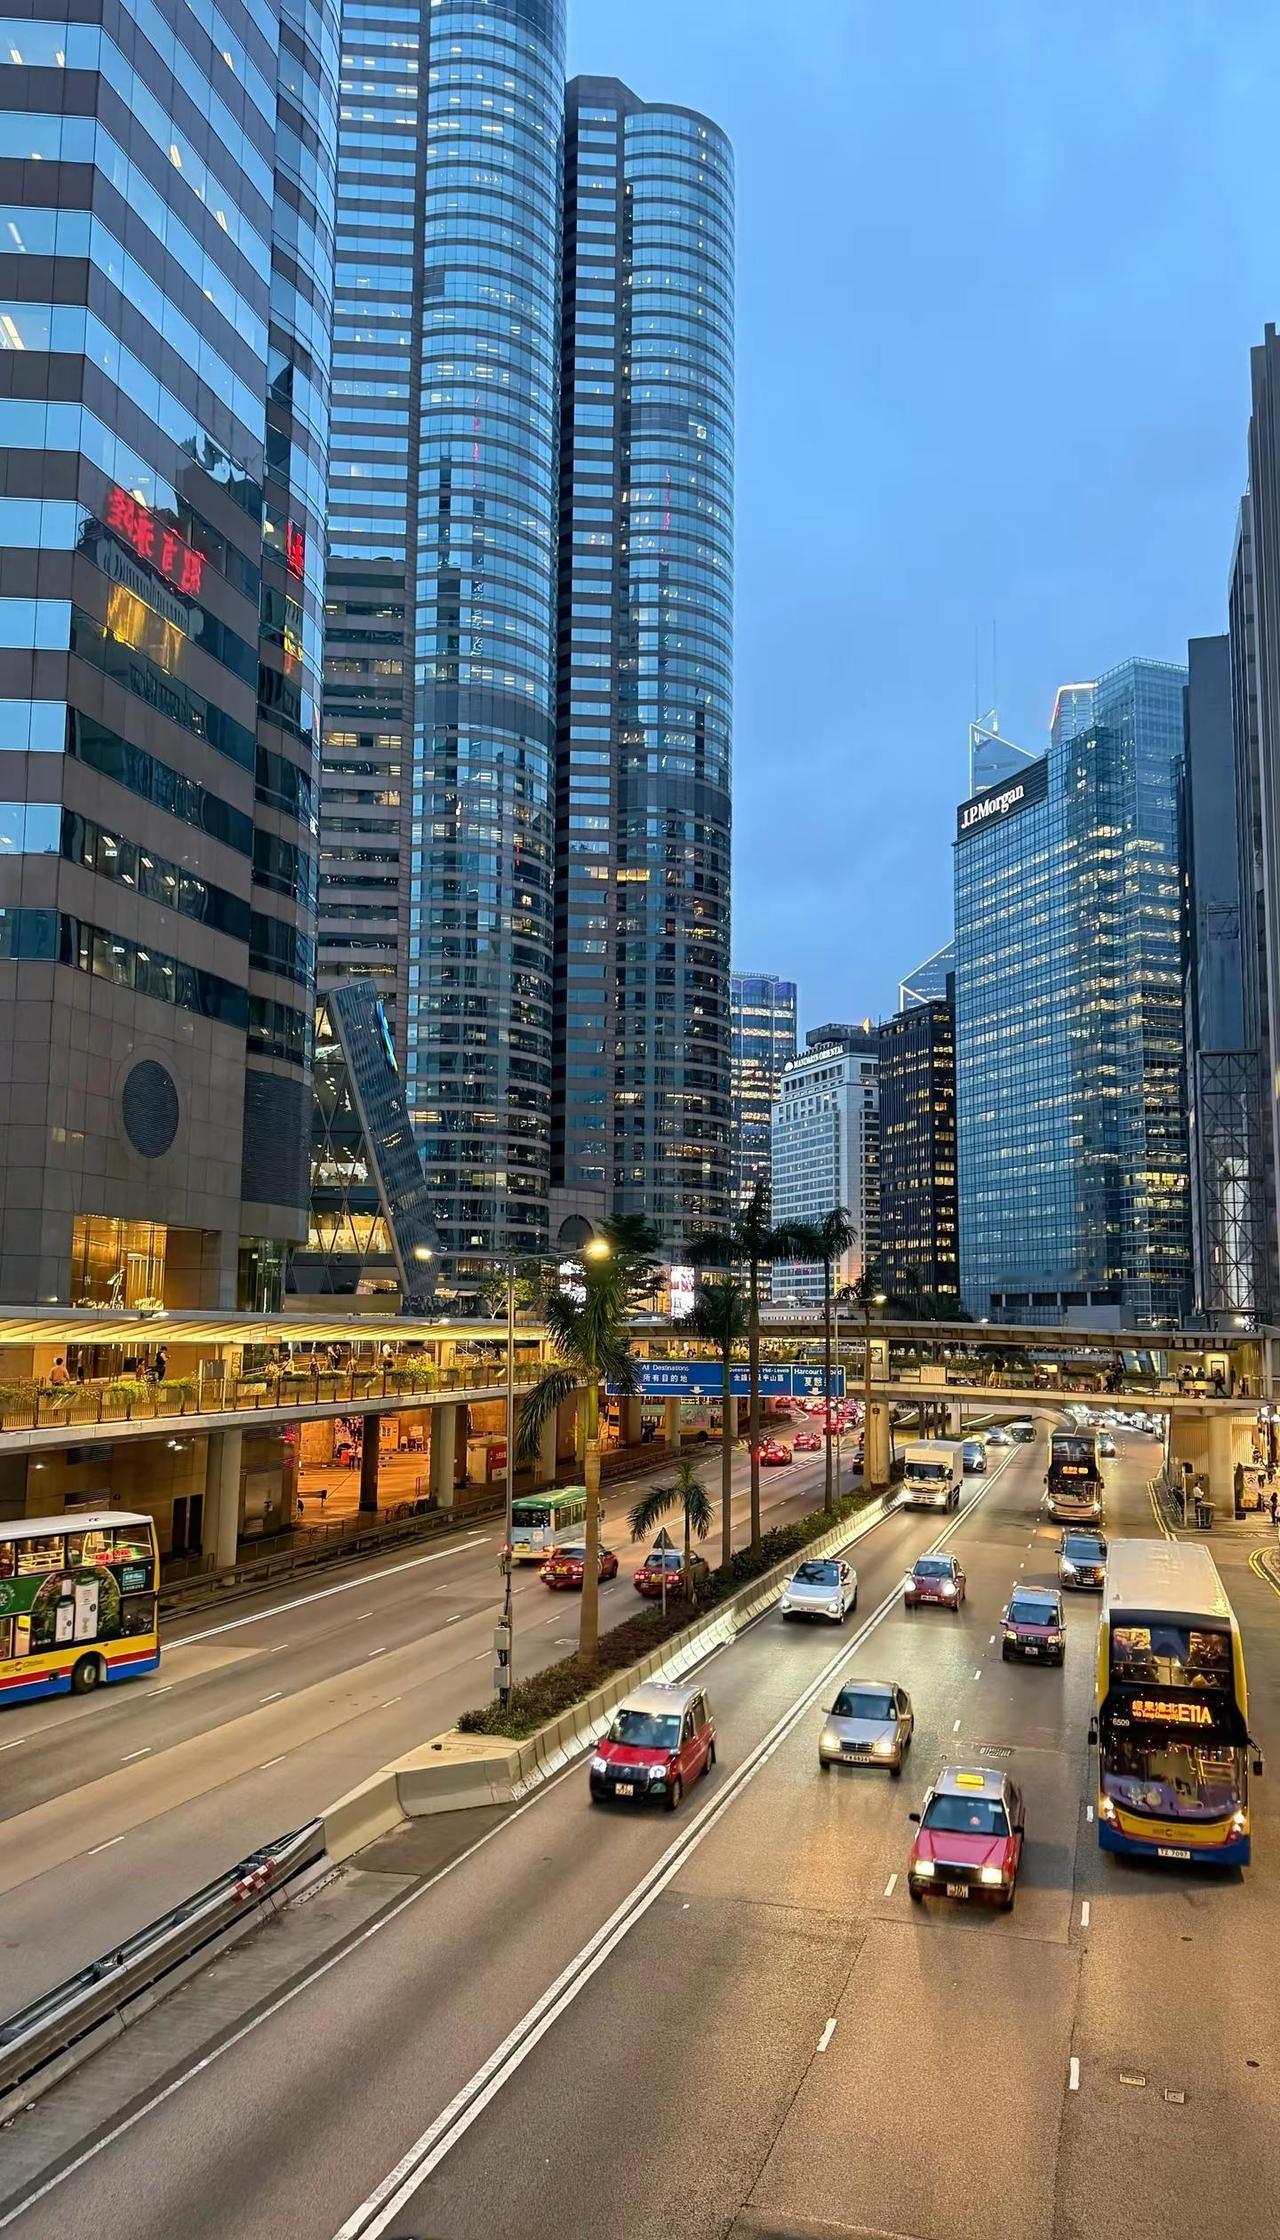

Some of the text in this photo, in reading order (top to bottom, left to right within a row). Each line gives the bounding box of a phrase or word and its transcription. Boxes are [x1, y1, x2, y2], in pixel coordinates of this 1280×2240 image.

[652, 1364, 690, 1372] Destinations
[642, 1373, 688, 1383] 所有目的地
[1178, 1703, 1213, 1725] E11A
[1112, 1718, 1130, 1727] 6509
